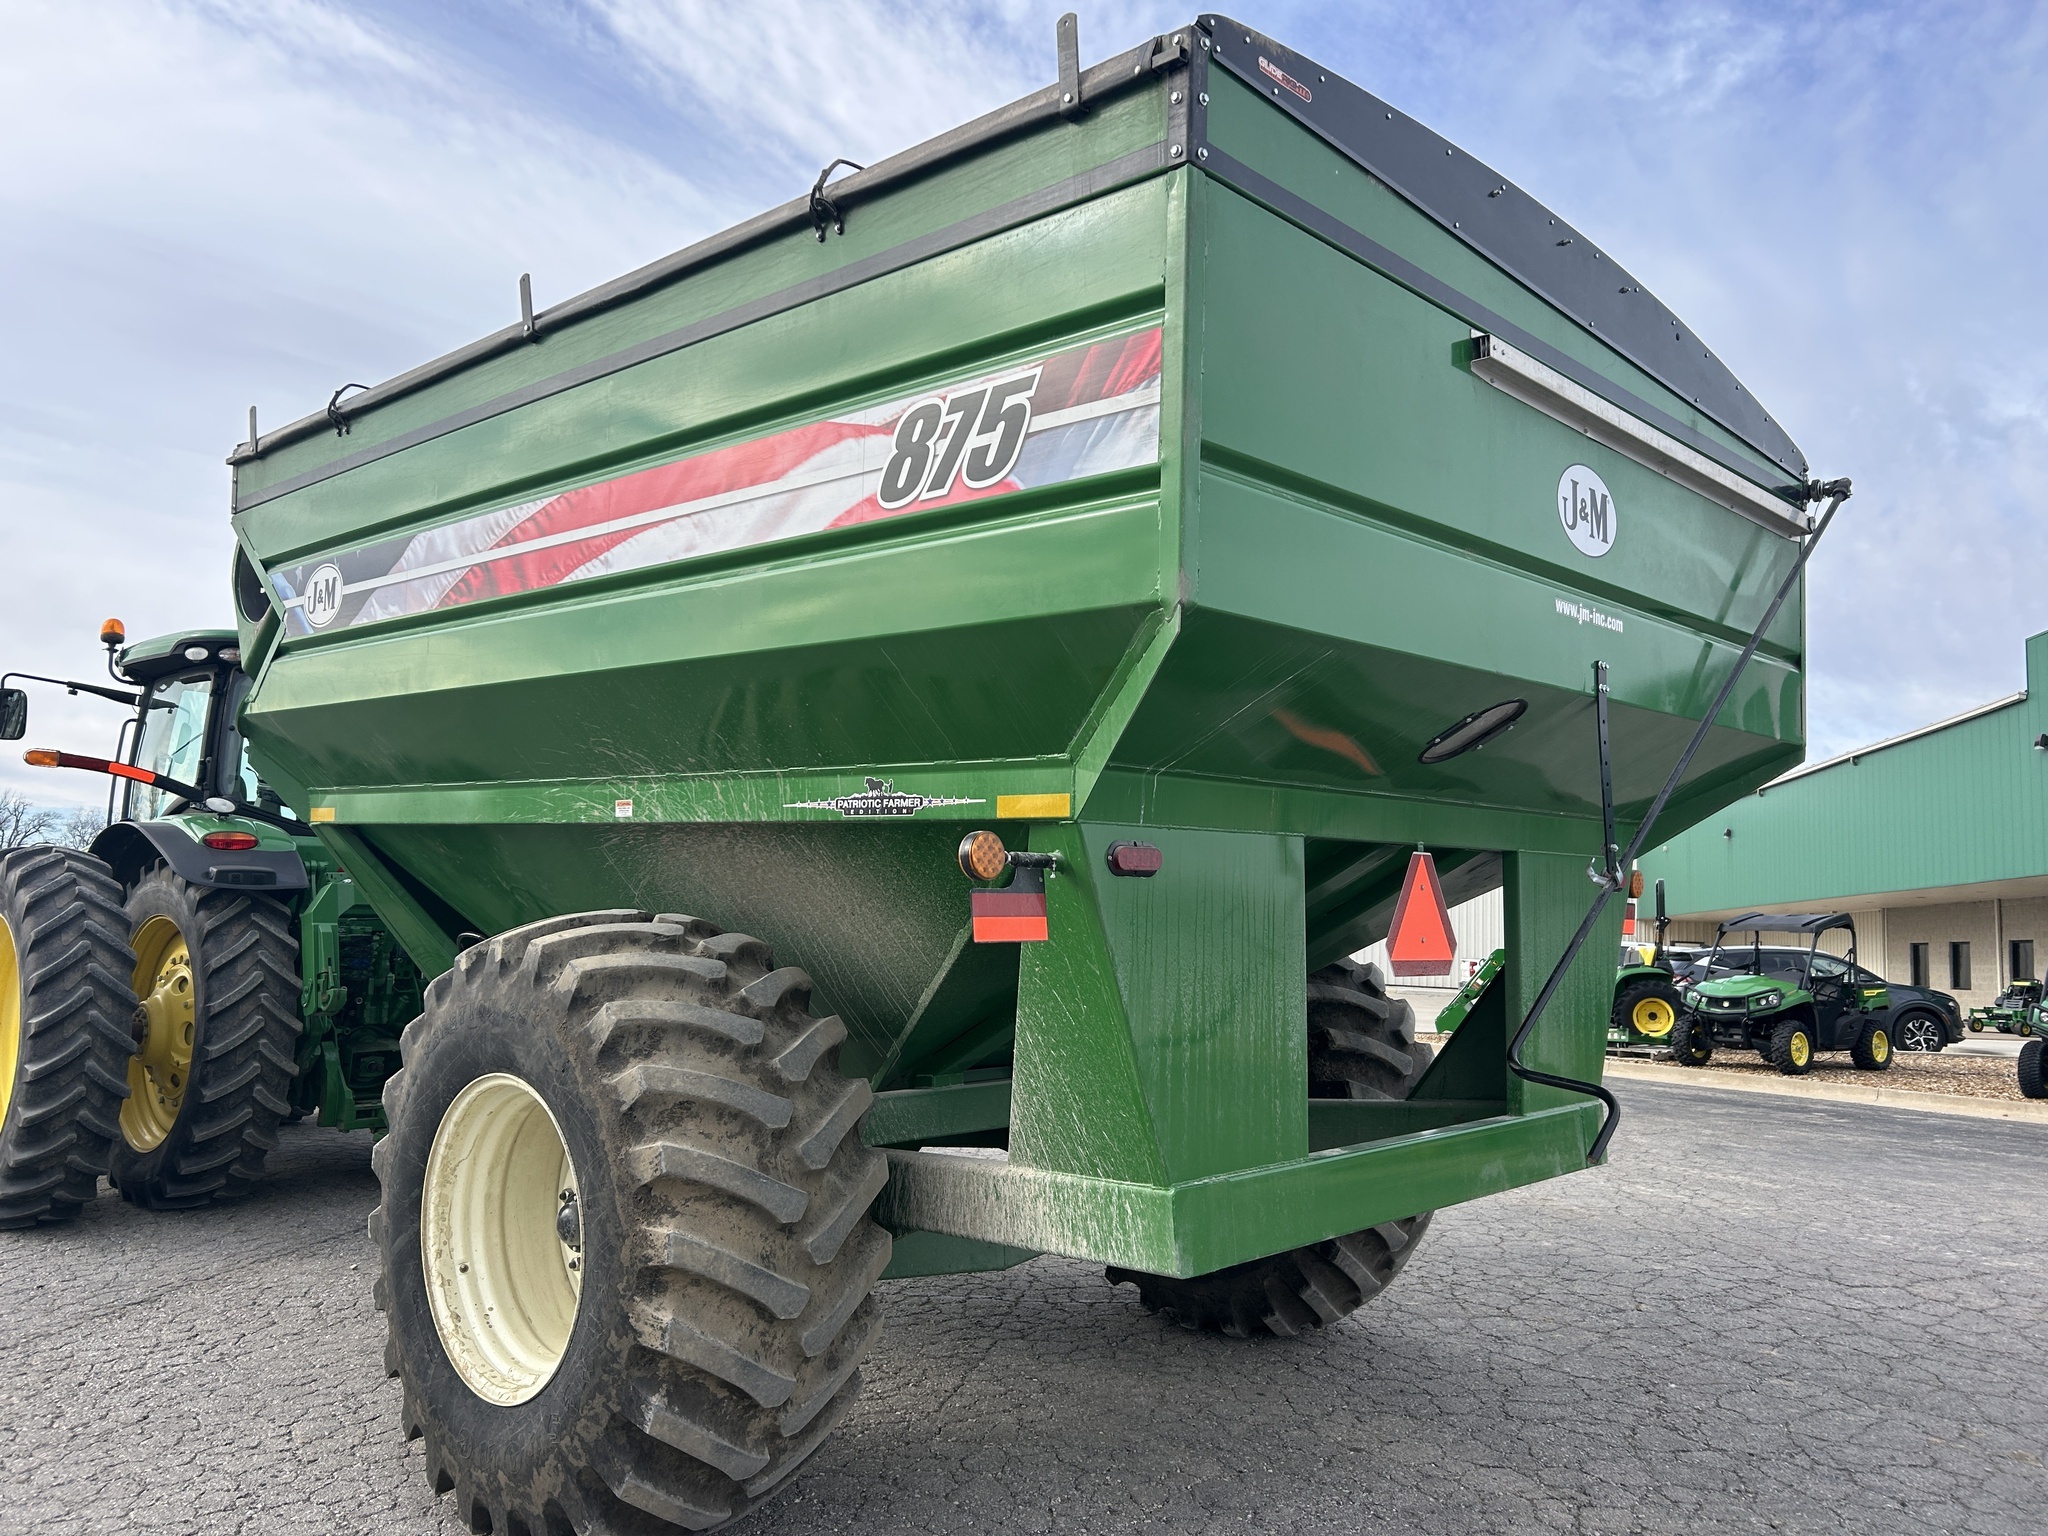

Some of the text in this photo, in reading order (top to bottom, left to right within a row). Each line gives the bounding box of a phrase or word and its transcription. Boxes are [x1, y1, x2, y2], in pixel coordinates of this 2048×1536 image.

[877, 366, 1043, 509] 875
[1562, 478, 1609, 545] J&M
[307, 576, 337, 615] J&M
[1555, 599, 1623, 633] www.jm-inc.com
[837, 798, 921, 809] PATRIOTIC FARMER
